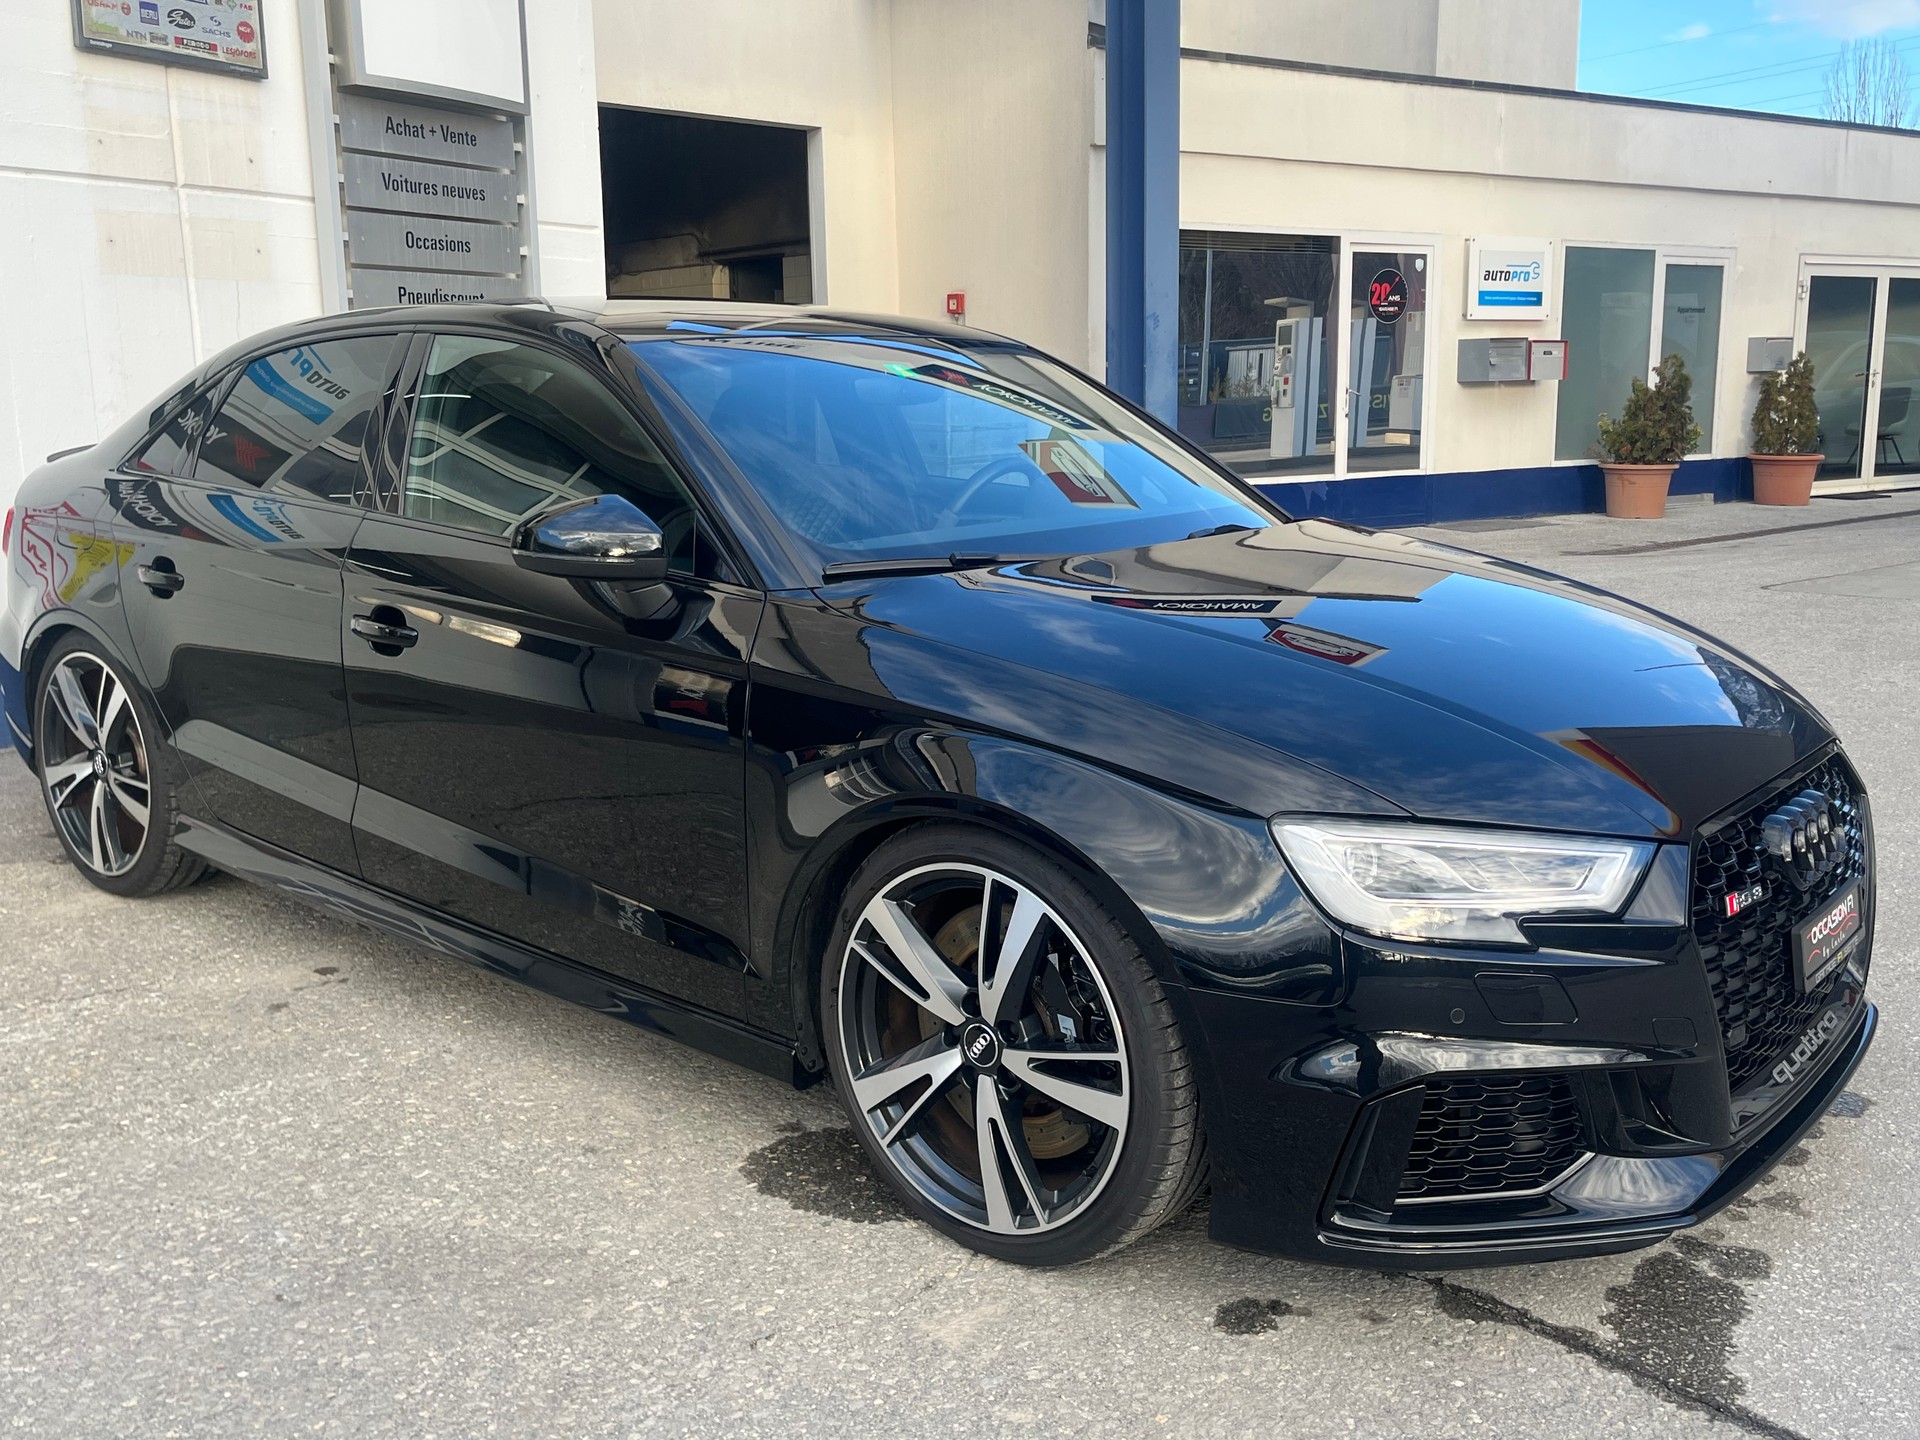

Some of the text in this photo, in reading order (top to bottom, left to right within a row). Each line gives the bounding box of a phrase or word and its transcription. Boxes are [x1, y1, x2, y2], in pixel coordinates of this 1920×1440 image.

[168, 11, 195, 27] Gates
[126, 30, 148, 41] NTN
[202, 27, 232, 38] SACHS
[385, 115, 477, 147] Achat + Vente
[381, 172, 486, 202] Voitures neuves
[405, 231, 472, 254] Occasions
[1811, 899, 1848, 945] OCCASION
[1772, 1010, 1838, 1083] quattro
